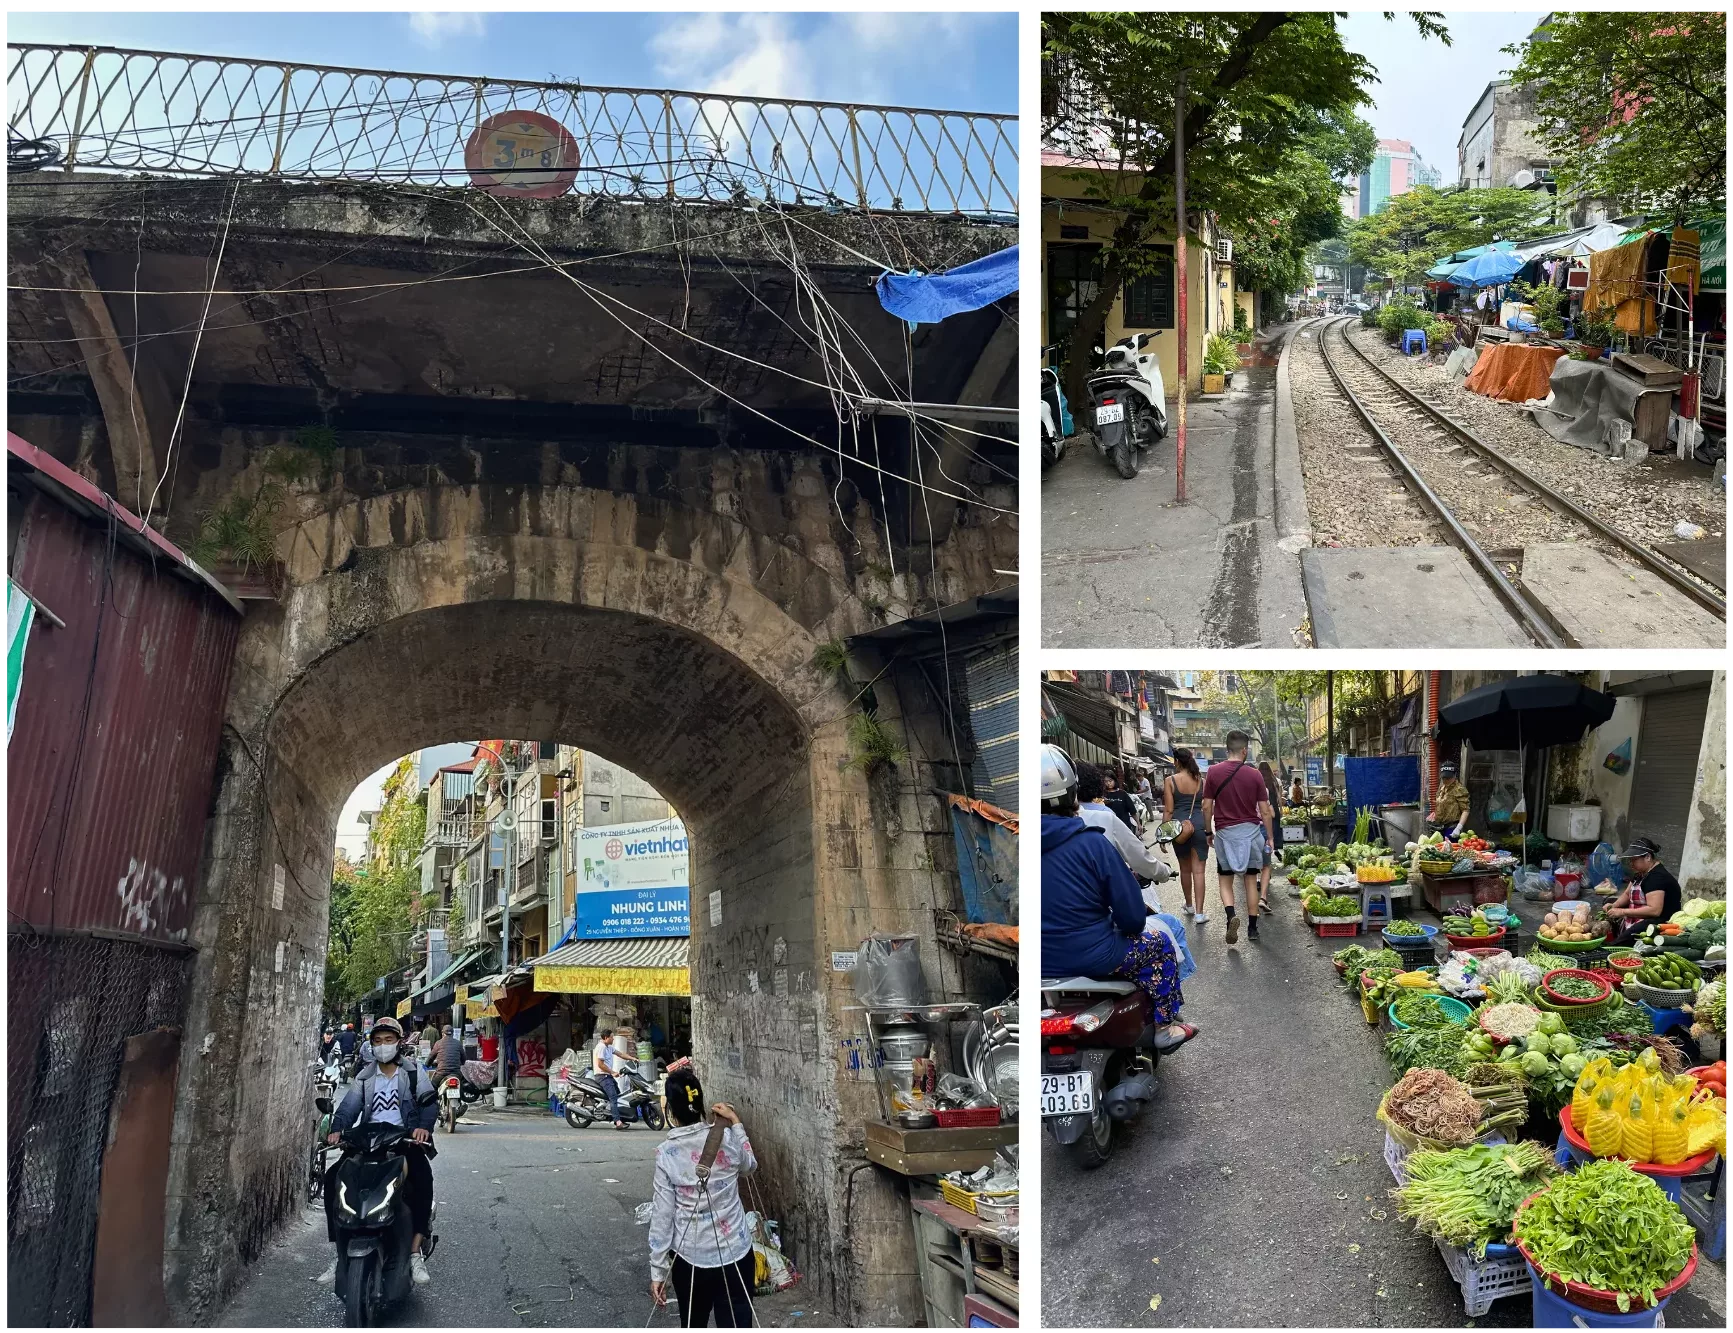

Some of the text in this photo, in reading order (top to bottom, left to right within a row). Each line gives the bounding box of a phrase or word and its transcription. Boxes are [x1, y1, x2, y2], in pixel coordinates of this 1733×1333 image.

[494, 140, 516, 168] 3
[541, 150, 552, 168] 8
[611, 900, 687, 915] NHUNG LINH
[632, 917, 645, 925] 222
[650, 916, 667, 924] 0934
[1042, 1075, 1082, 1094] 29-B1
